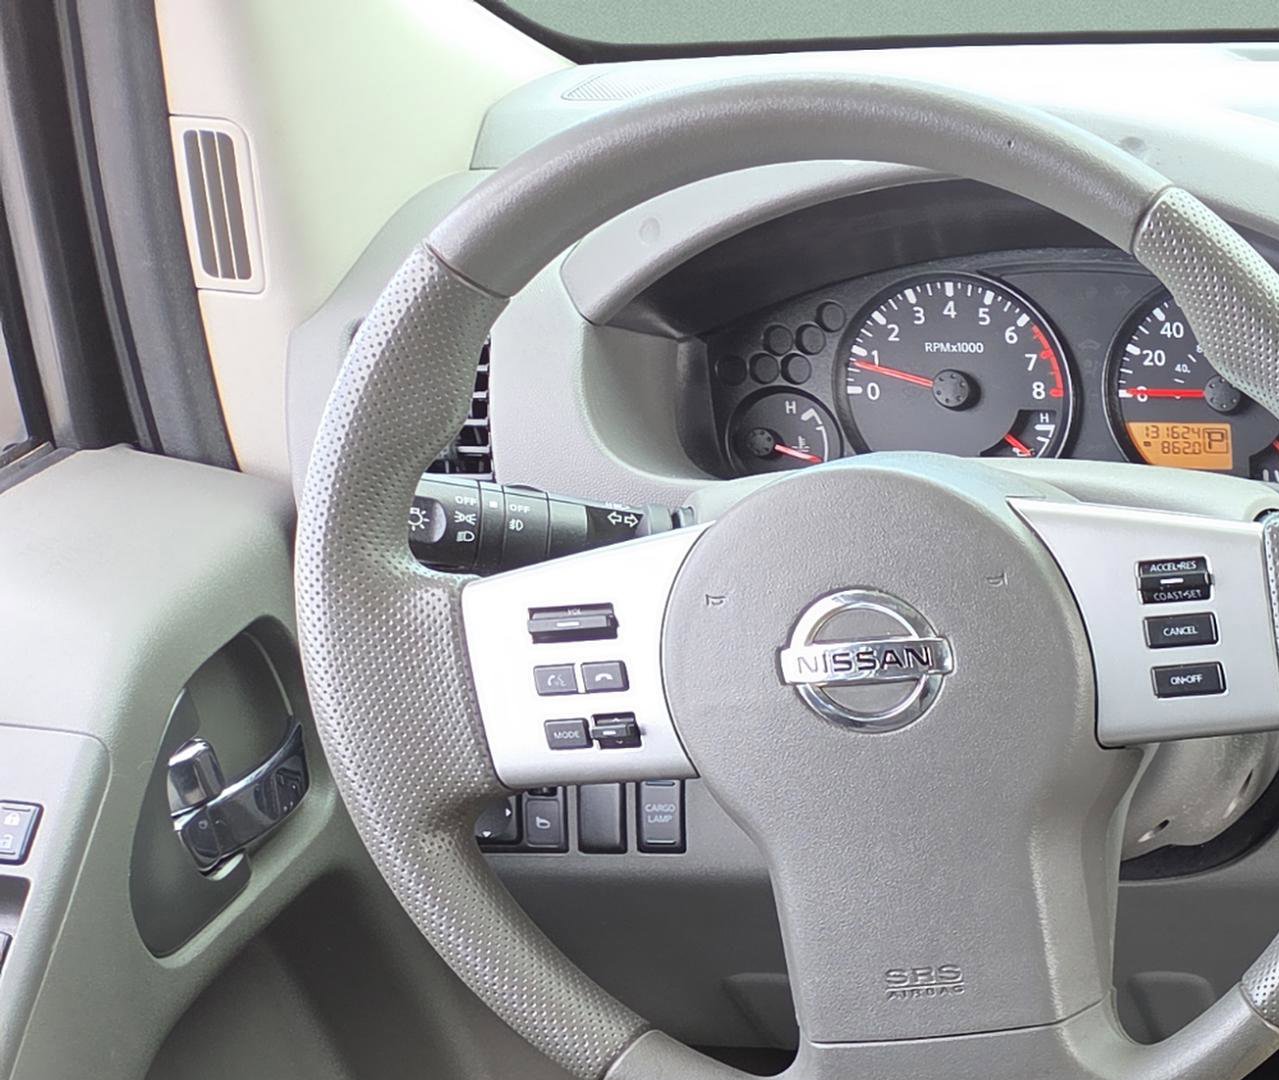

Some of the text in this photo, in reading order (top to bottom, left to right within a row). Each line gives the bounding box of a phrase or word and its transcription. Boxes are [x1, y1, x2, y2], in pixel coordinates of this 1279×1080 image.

[913, 306, 925, 325] 3
[943, 301, 957, 319] 4
[978, 308, 991, 326] 5
[887, 324, 900, 341] 2
[1005, 327, 1018, 344] 6
[1160, 322, 1184, 338] 40
[1025, 353, 1037, 371] 7
[1142, 349, 1166, 366] 20
[867, 383, 880, 400] 0
[1032, 382, 1045, 399] 8
[785, 401, 796, 414] H
[1040, 412, 1049, 423] H
[1145, 425, 1201, 439] 131624
[455, 495, 477, 505] OFF
[509, 503, 530, 513] OFF
[1163, 625, 1198, 636] CANCEL
[796, 646, 934, 675] NISSAN
[553, 731, 580, 739] MODE
[644, 804, 676, 814] CARGO
[648, 815, 673, 824] LAMP
[885, 964, 963, 986] SRS
